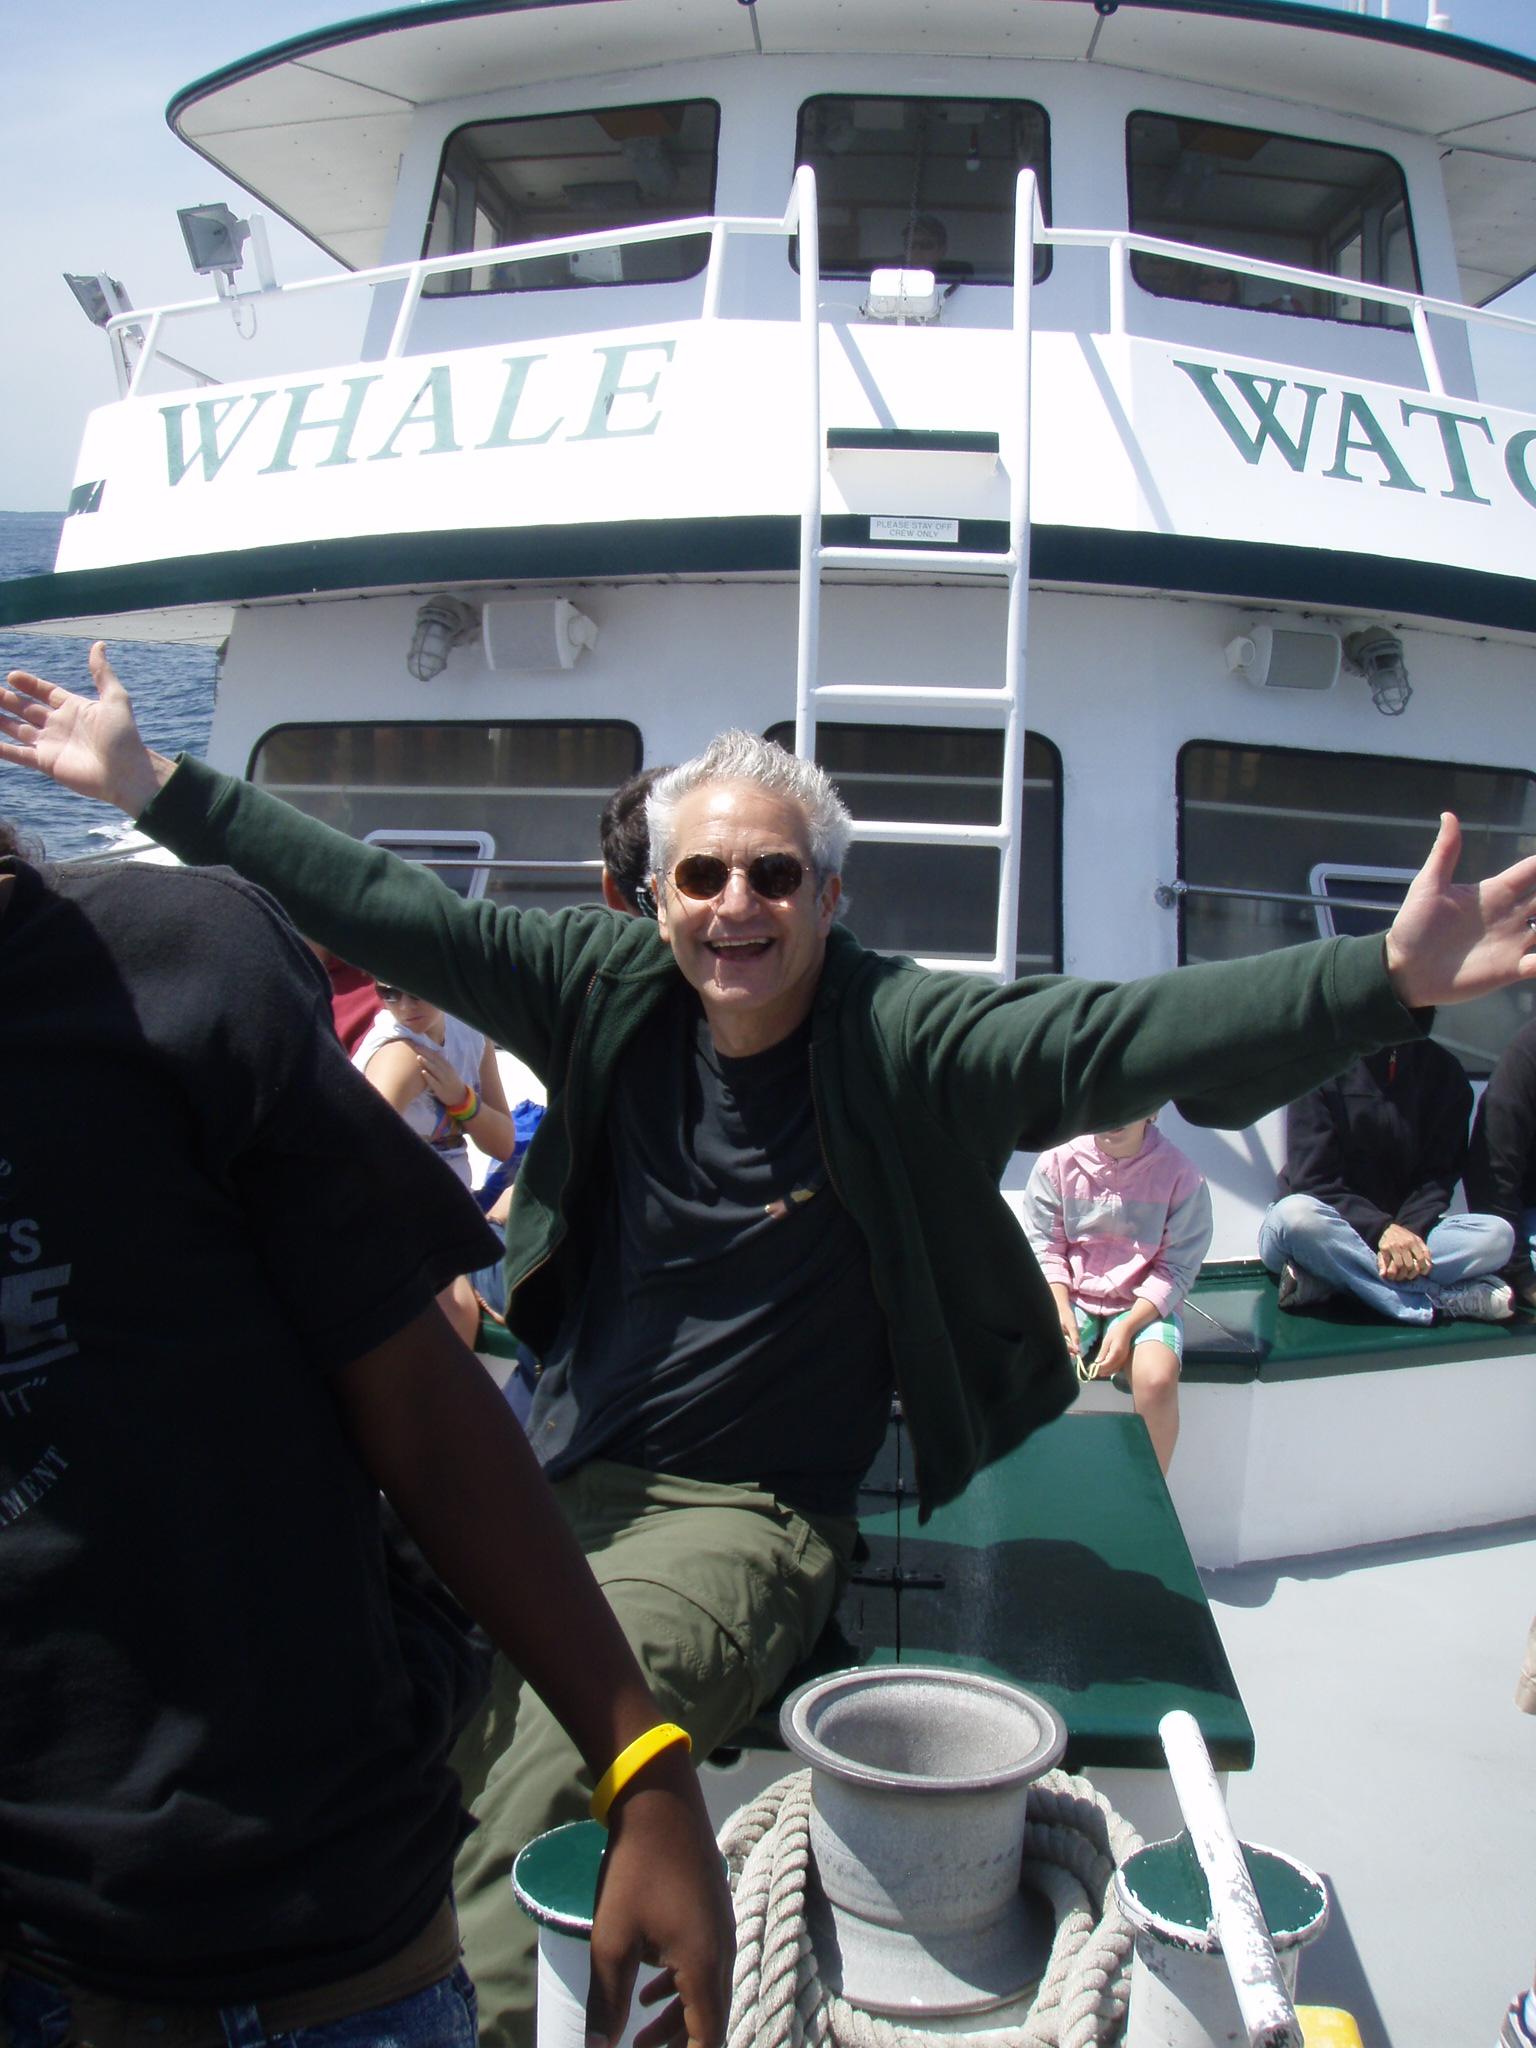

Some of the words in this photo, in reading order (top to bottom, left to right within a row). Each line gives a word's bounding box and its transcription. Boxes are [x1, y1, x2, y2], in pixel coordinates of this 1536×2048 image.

[158, 340, 677, 487] WHALE
[876, 520, 910, 529] PLEASE
[911, 521, 933, 530] STAY
[935, 523, 953, 531] OFF
[889, 529, 915, 537] CREW
[917, 530, 939, 538] ONLY
[0, 1444, 70, 1526] MENT
